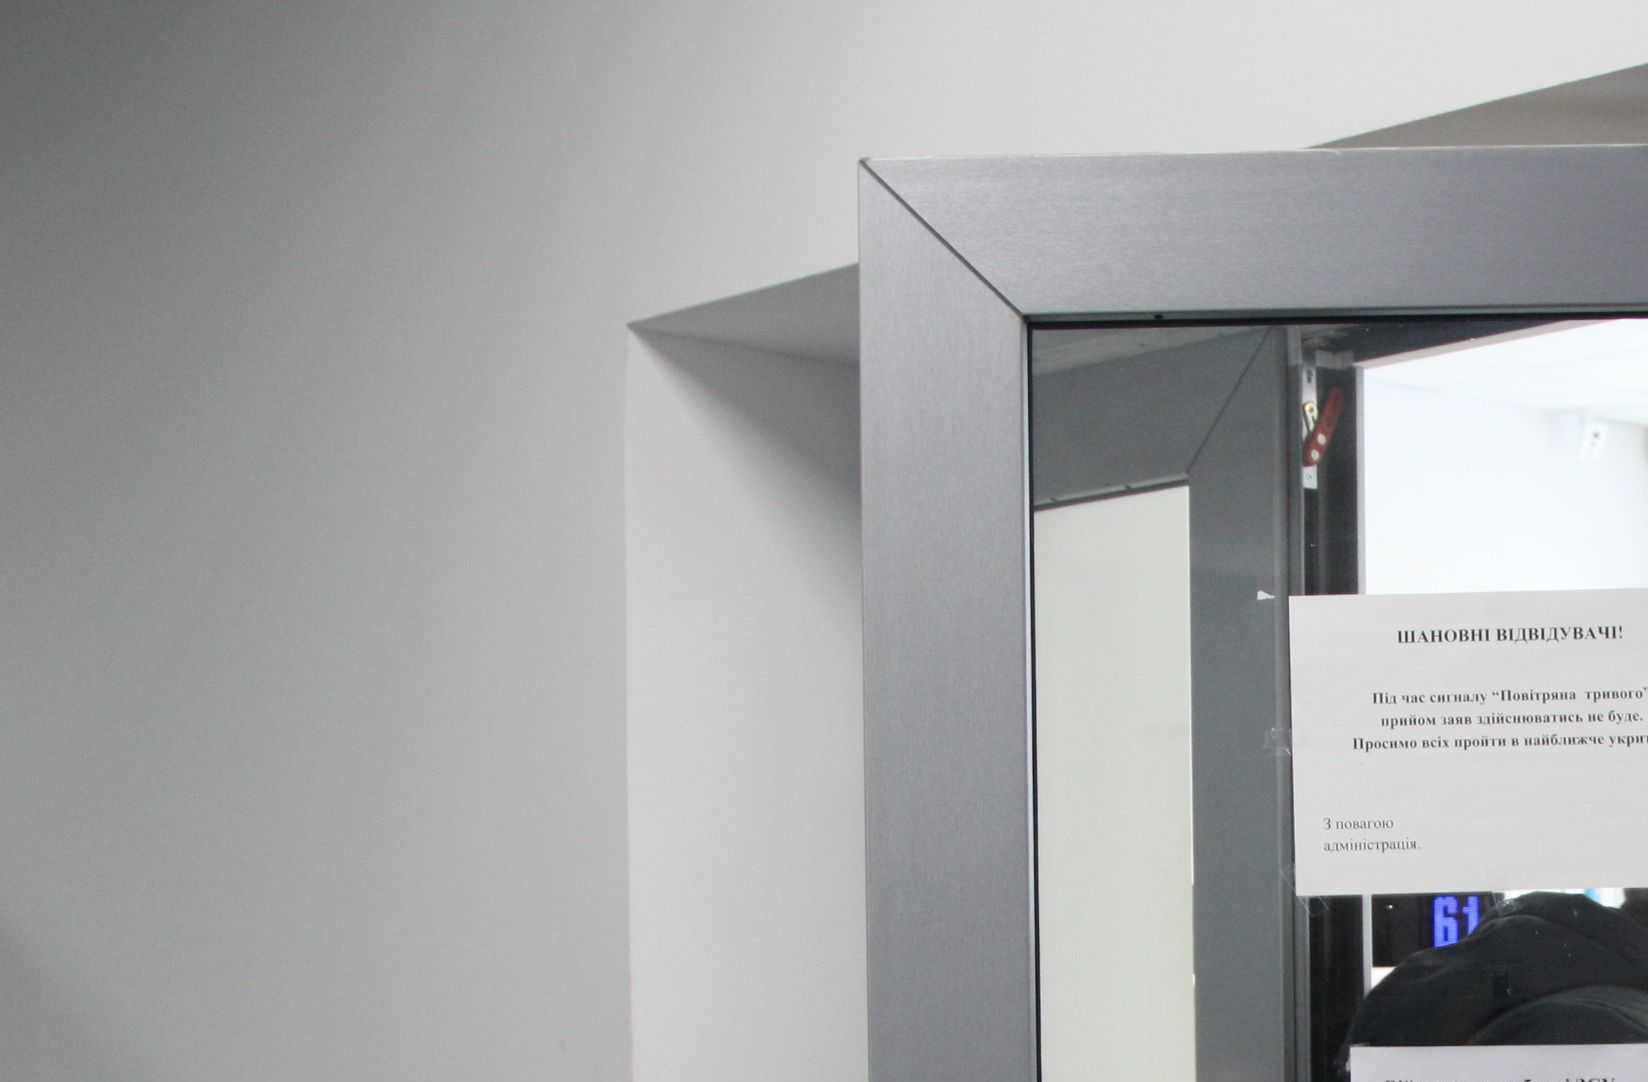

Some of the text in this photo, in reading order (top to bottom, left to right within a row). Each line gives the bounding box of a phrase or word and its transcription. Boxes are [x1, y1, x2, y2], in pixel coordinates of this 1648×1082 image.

[1397, 625, 1624, 644] ШАНОВНІ ВІДВІДУВАЧІ!
[1372, 692, 1397, 705] Під
[1401, 693, 1426, 704] час
[1429, 691, 1487, 705] сигналу
[1380, 709, 1643, 730] прийом заяв здійснюватись не буде.
[1352, 737, 1417, 752] Просимо
[1421, 735, 1450, 749] всіх
[1454, 735, 1507, 751] пройти
[1511, 736, 1520, 747] в
[1524, 733, 1605, 747] найближче
[1335, 819, 1395, 830] повагою
[1433, 896, 1481, 950] 61
